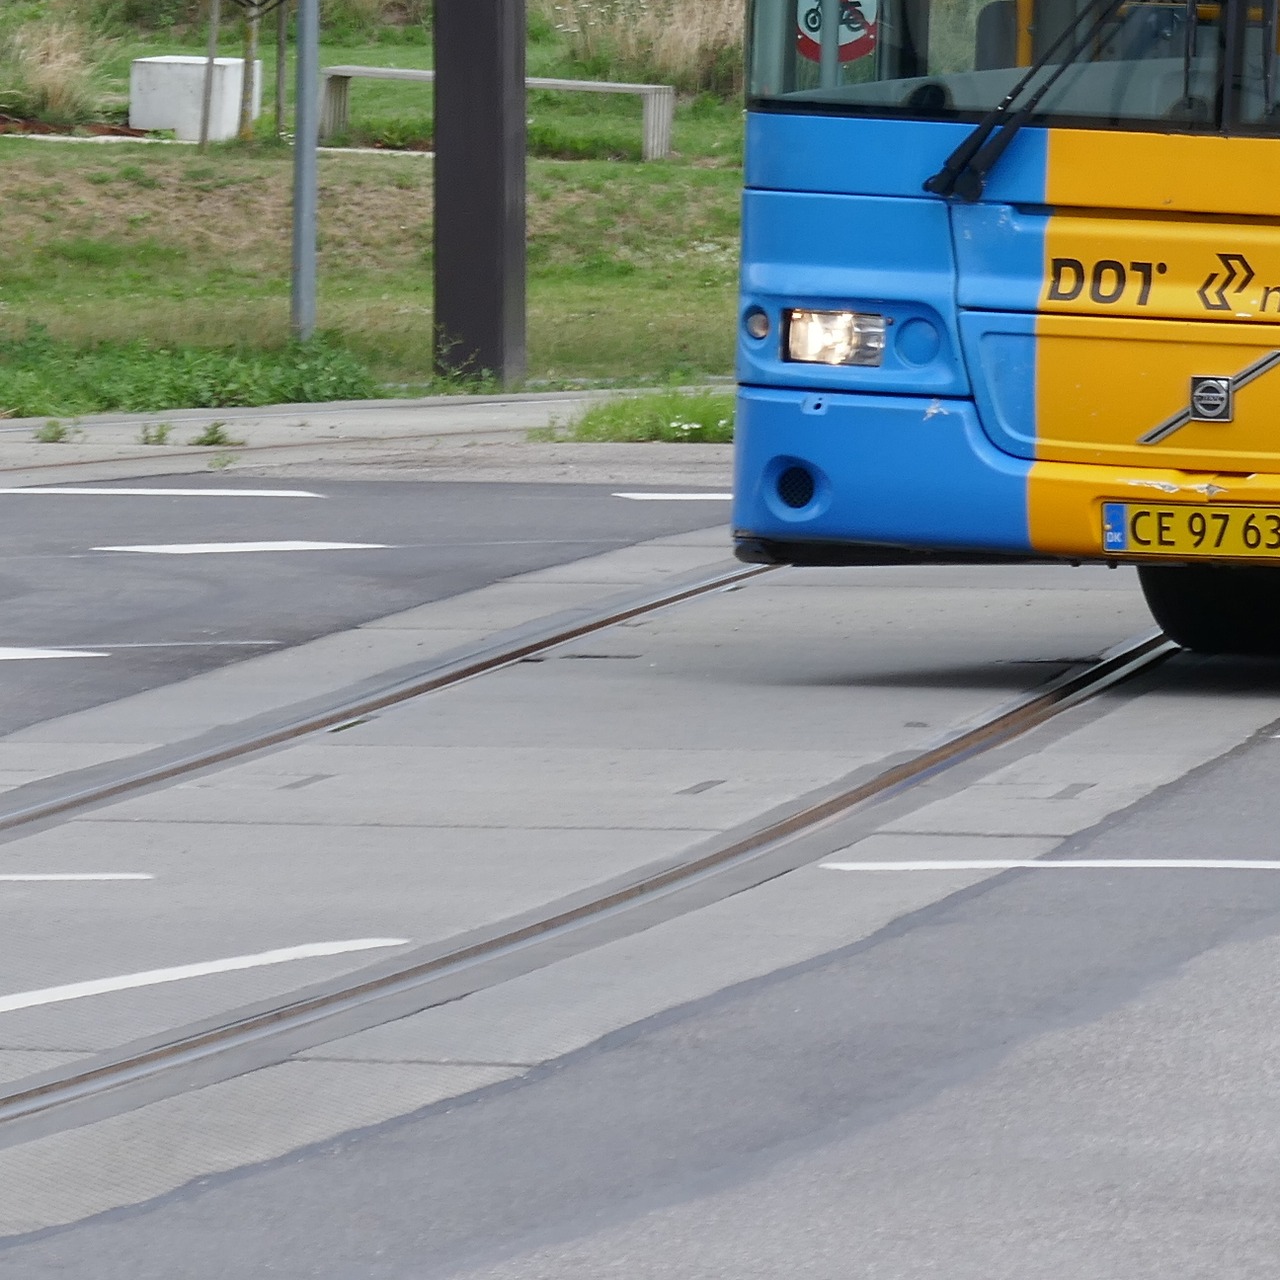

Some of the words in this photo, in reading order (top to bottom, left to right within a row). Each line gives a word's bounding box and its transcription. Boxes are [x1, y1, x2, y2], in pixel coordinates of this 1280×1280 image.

[1106, 531, 1123, 543] DK
[1130, 510, 1176, 546] CE
[1187, 512, 1230, 549] 97
